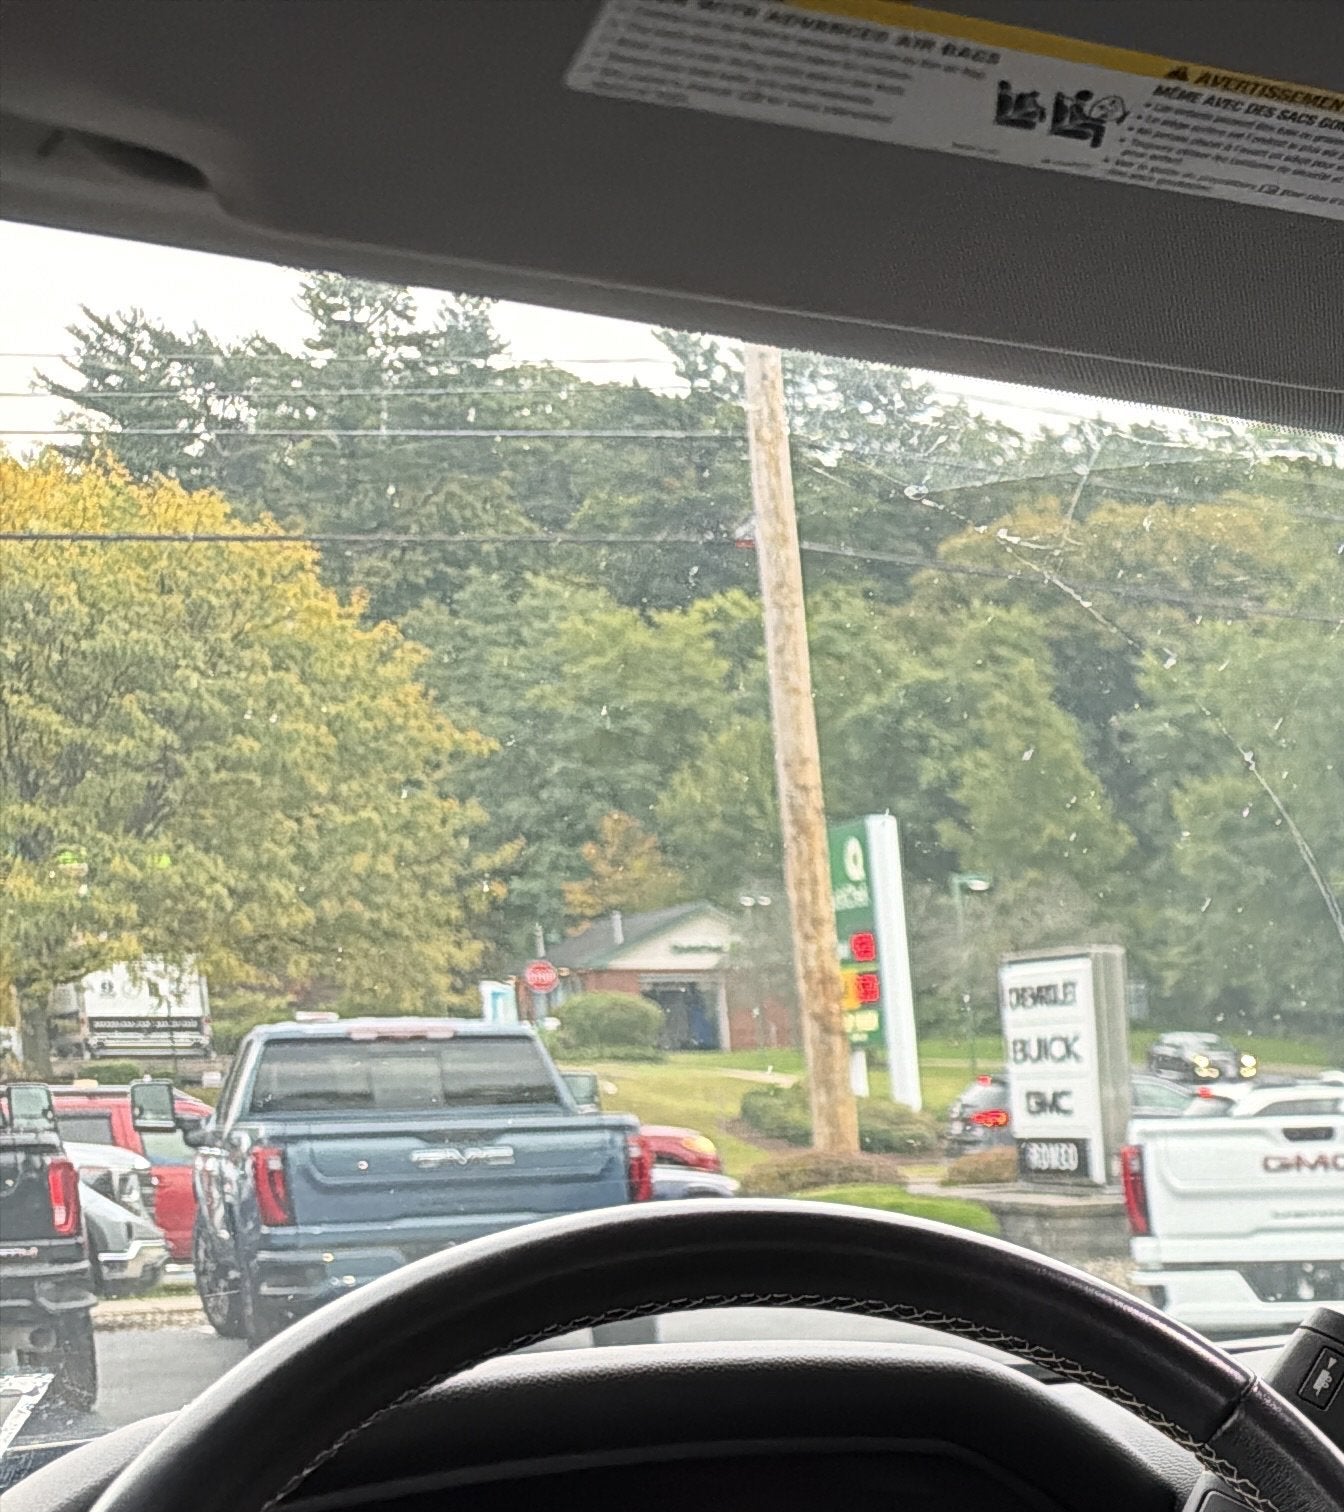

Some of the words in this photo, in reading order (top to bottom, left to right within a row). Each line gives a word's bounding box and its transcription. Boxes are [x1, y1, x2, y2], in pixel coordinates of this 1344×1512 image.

[1203, 94, 1244, 113] AVEC
[1245, 101, 1276, 119] DES
[1278, 107, 1319, 127] SACS
[1012, 1035, 1083, 1064] BUICK
